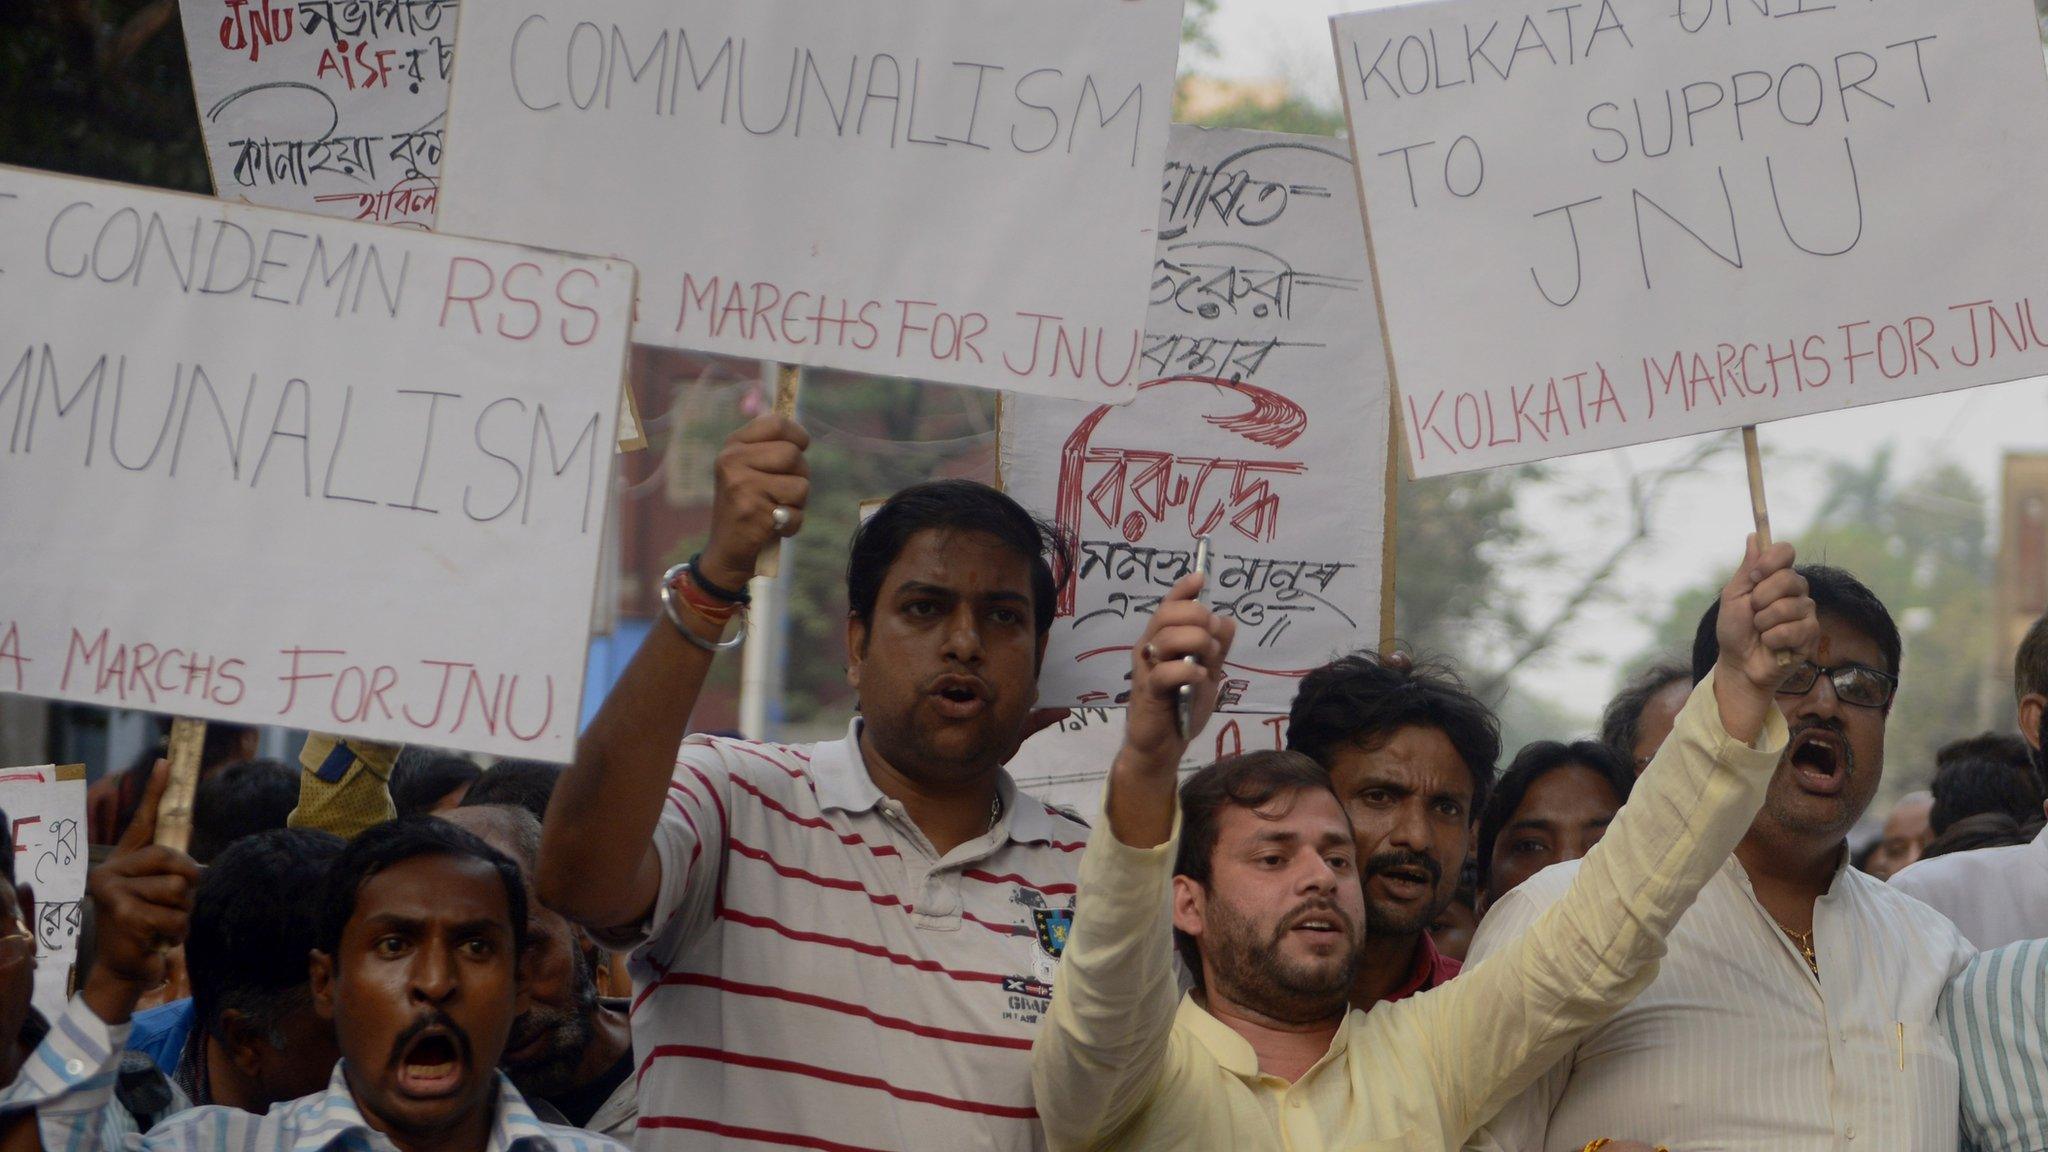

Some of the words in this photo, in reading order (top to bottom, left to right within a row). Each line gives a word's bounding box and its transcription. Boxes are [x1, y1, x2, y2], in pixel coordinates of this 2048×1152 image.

[220, 0, 293, 62] JNU
[509, 14, 1144, 167] COMMUNALISM
[1354, 2, 1634, 100] KOLKATA
[1378, 135, 1485, 208] TO
[1586, 35, 1938, 164] SUPPORT
[44, 200, 411, 319] CONDEMN
[438, 256, 600, 346] RSS
[1531, 137, 1862, 307] JNU
[675, 272, 882, 350] MARCHS
[895, 299, 988, 365] FOR
[1408, 361, 1627, 460] KOLKATA
[1643, 334, 1831, 420] MARCHS
[1838, 316, 1940, 385] FOR
[60, 627, 246, 706] MARCHS
[278, 645, 398, 724] FOR
